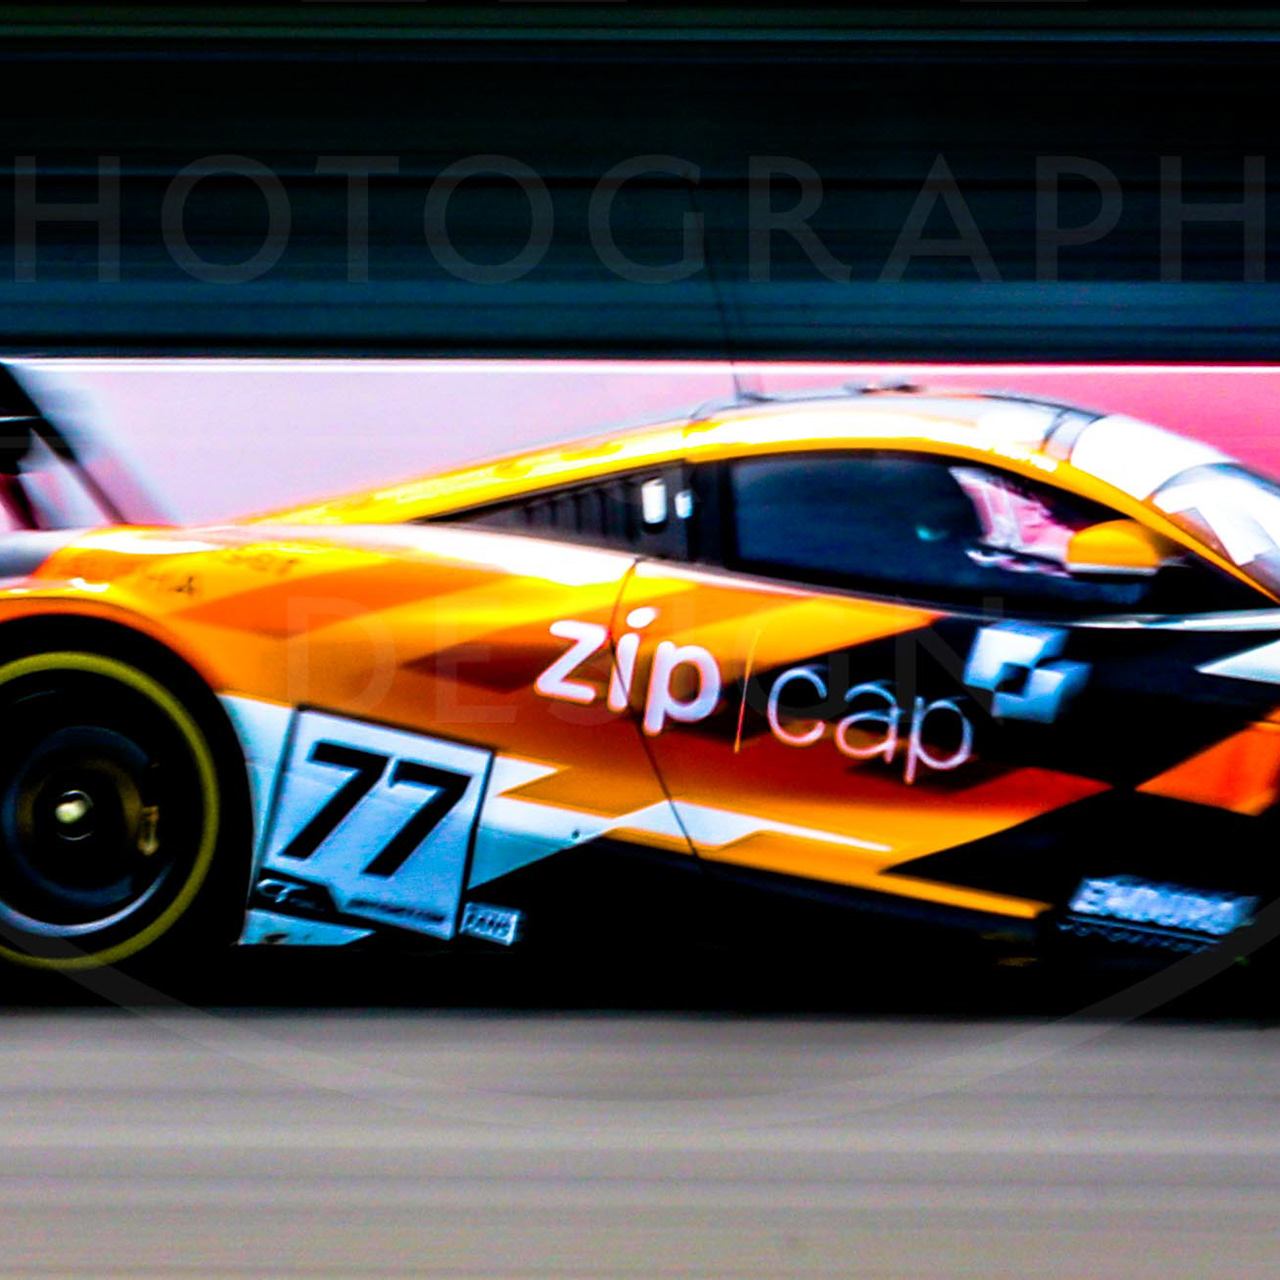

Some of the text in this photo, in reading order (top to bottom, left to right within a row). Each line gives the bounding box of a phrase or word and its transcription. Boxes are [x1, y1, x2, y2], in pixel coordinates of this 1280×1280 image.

[534, 606, 974, 785] zip cap
[281, 739, 472, 878] 77
